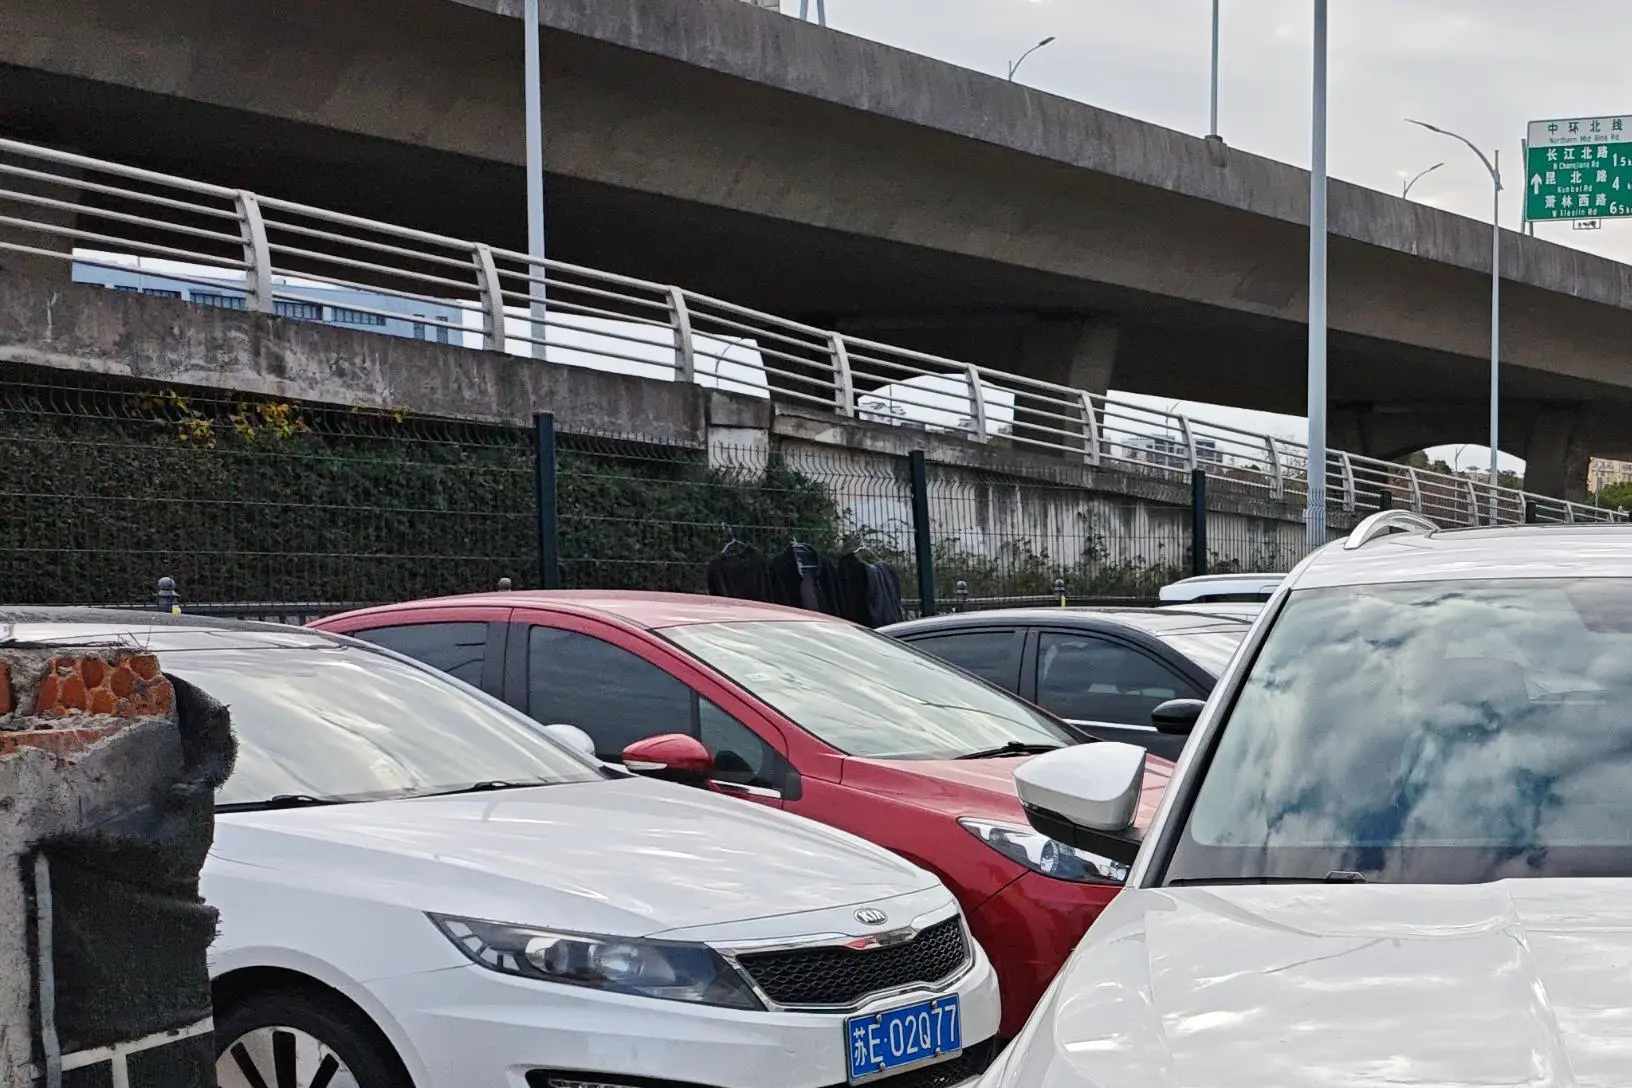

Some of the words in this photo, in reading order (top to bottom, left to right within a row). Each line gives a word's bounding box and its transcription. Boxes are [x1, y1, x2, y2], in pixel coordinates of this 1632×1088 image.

[1548, 119, 1623, 135] 中环北线
[1549, 136, 1577, 144] Northern
[1546, 146, 1608, 161] 长江北路
[1591, 160, 1600, 168] Rd
[1545, 170, 1607, 185] 昆北路
[1611, 176, 1620, 191] 4
[862, 908, 886, 923] KIA
